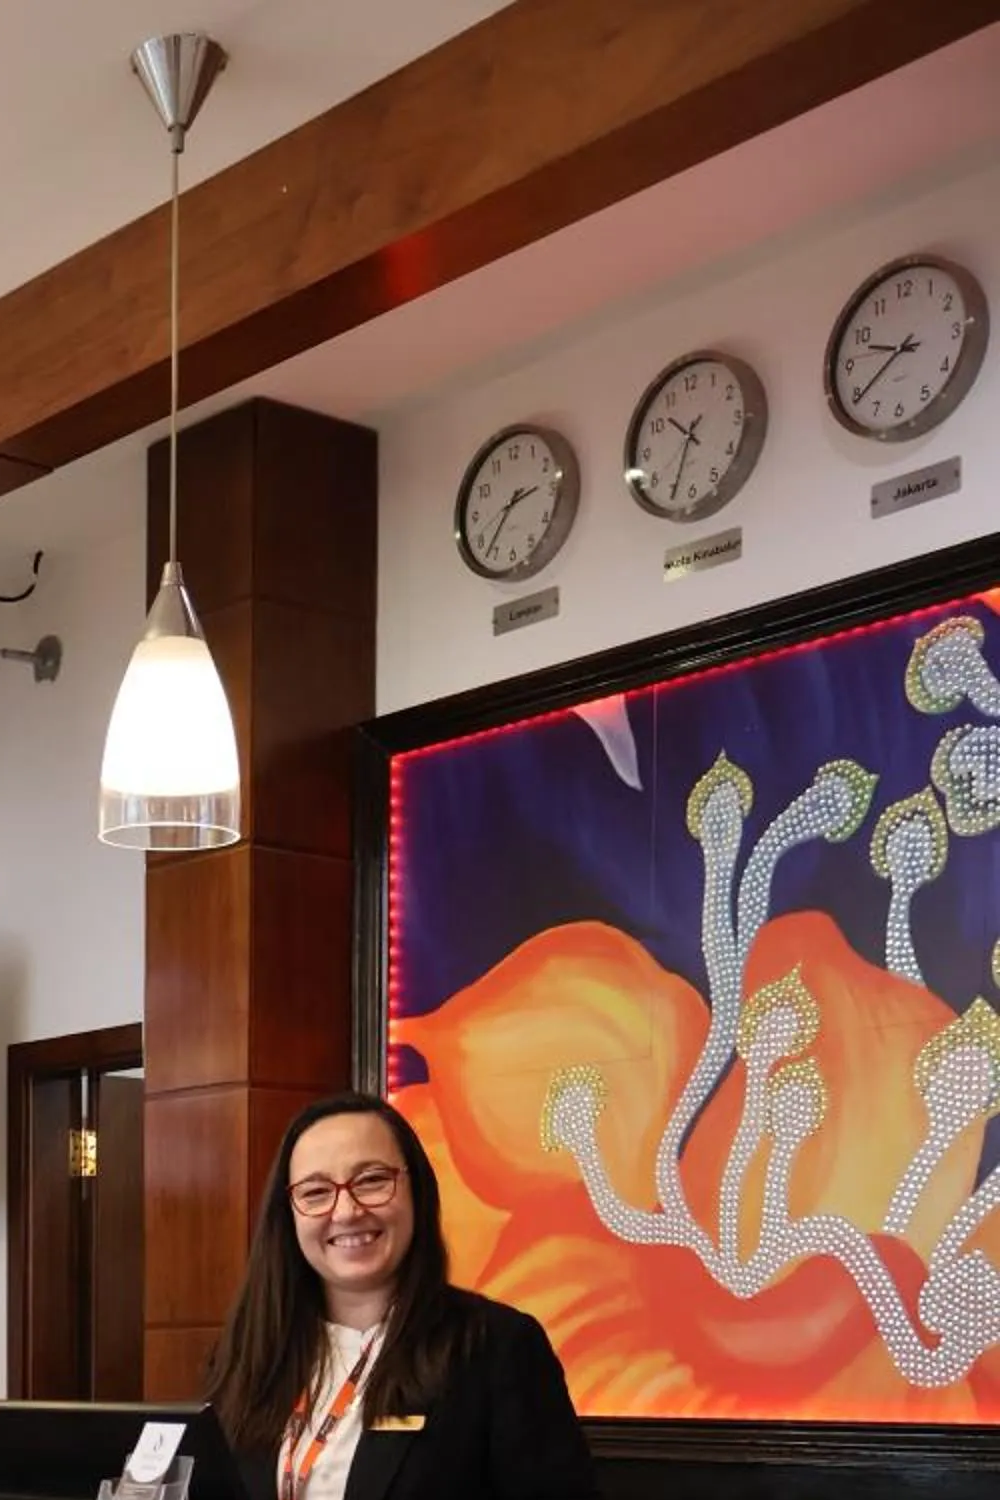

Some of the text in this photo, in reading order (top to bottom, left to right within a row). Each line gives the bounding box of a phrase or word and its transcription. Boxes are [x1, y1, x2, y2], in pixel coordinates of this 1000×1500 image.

[897, 280, 913, 298] 12
[874, 300, 885, 317] 11
[855, 327, 871, 345] 10
[683, 374, 698, 392] 12
[665, 391, 677, 408] 11
[650, 417, 665, 434] 10
[508, 444, 519, 461] 12
[492, 459, 501, 476] 11
[479, 483, 491, 499] 10
